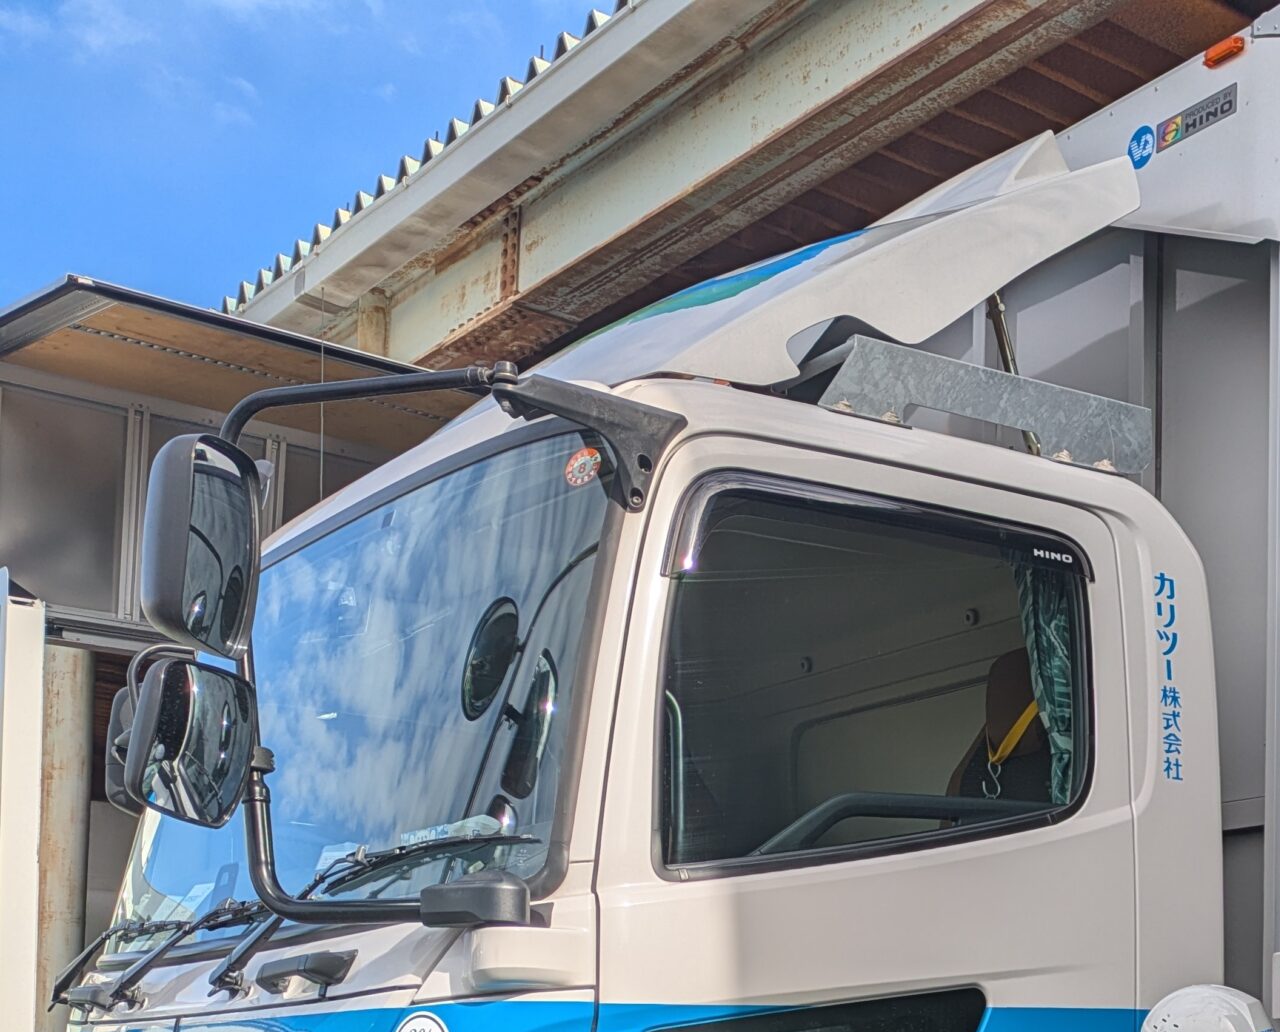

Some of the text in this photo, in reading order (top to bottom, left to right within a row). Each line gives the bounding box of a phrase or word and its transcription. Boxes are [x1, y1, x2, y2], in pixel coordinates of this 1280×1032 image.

[1184, 99, 1233, 133] HINO
[1185, 90, 1232, 118] PRODUCED BY
[1033, 548, 1073, 564] HINO
[1153, 572, 1184, 781] カリツー株式会社
